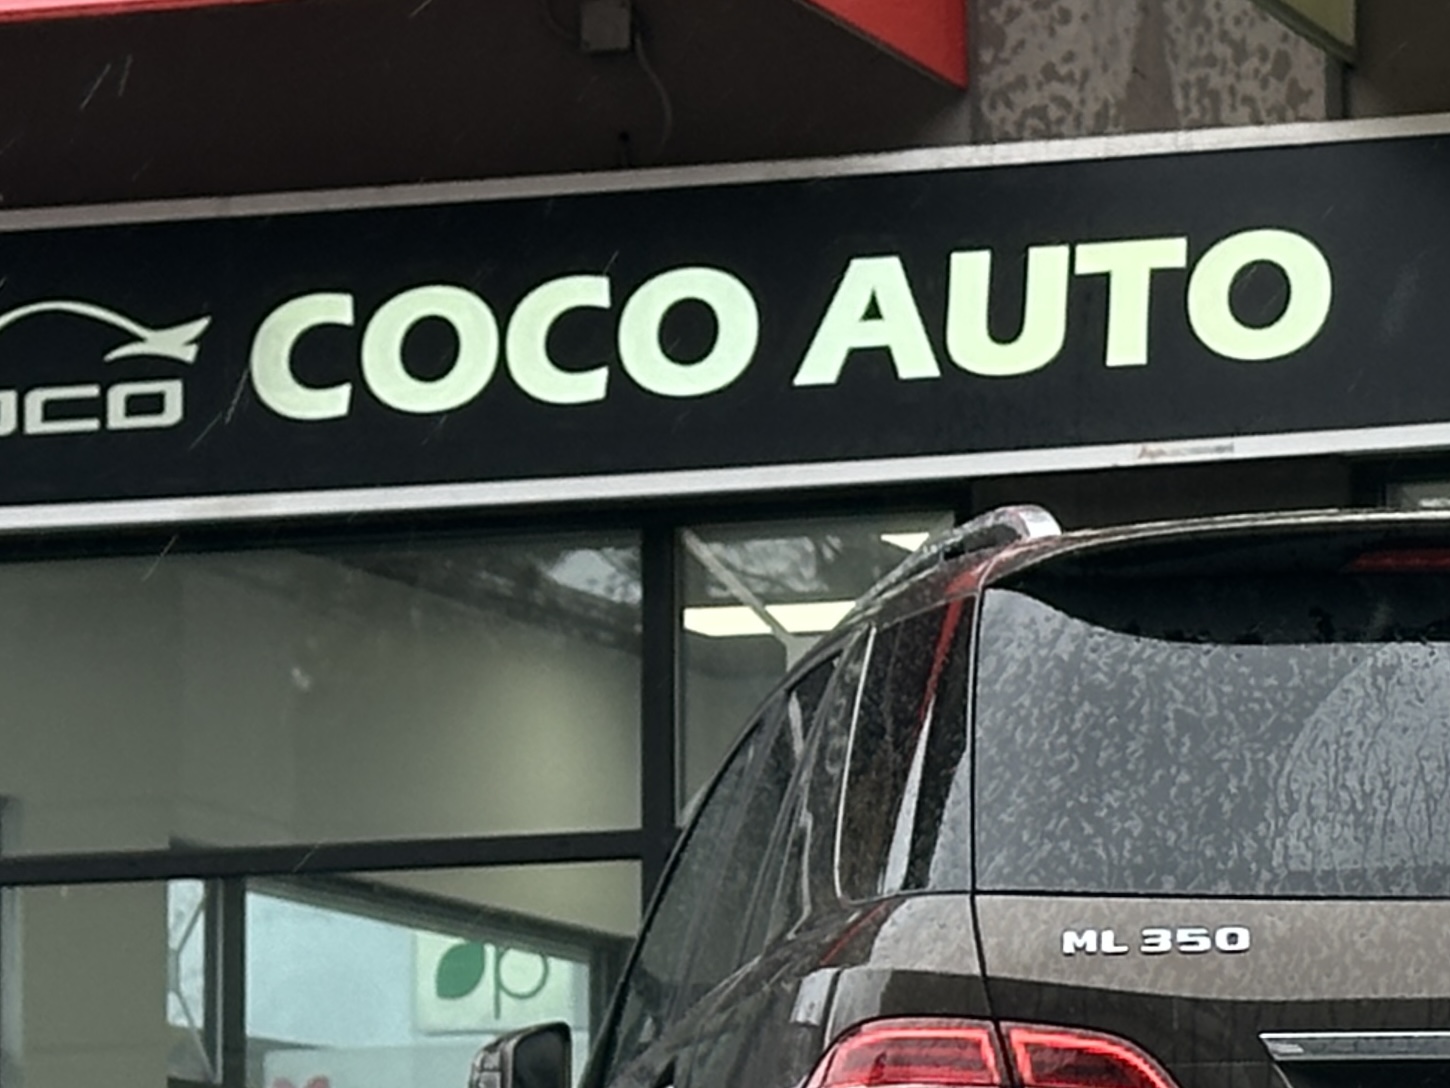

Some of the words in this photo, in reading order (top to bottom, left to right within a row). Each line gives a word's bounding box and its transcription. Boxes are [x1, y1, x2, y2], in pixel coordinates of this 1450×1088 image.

[250, 266, 760, 421] COCO
[792, 228, 1333, 387] AUTO
[0, 378, 184, 437] CO
[1062, 928, 1130, 954] ML
[1139, 926, 1251, 954] 350
